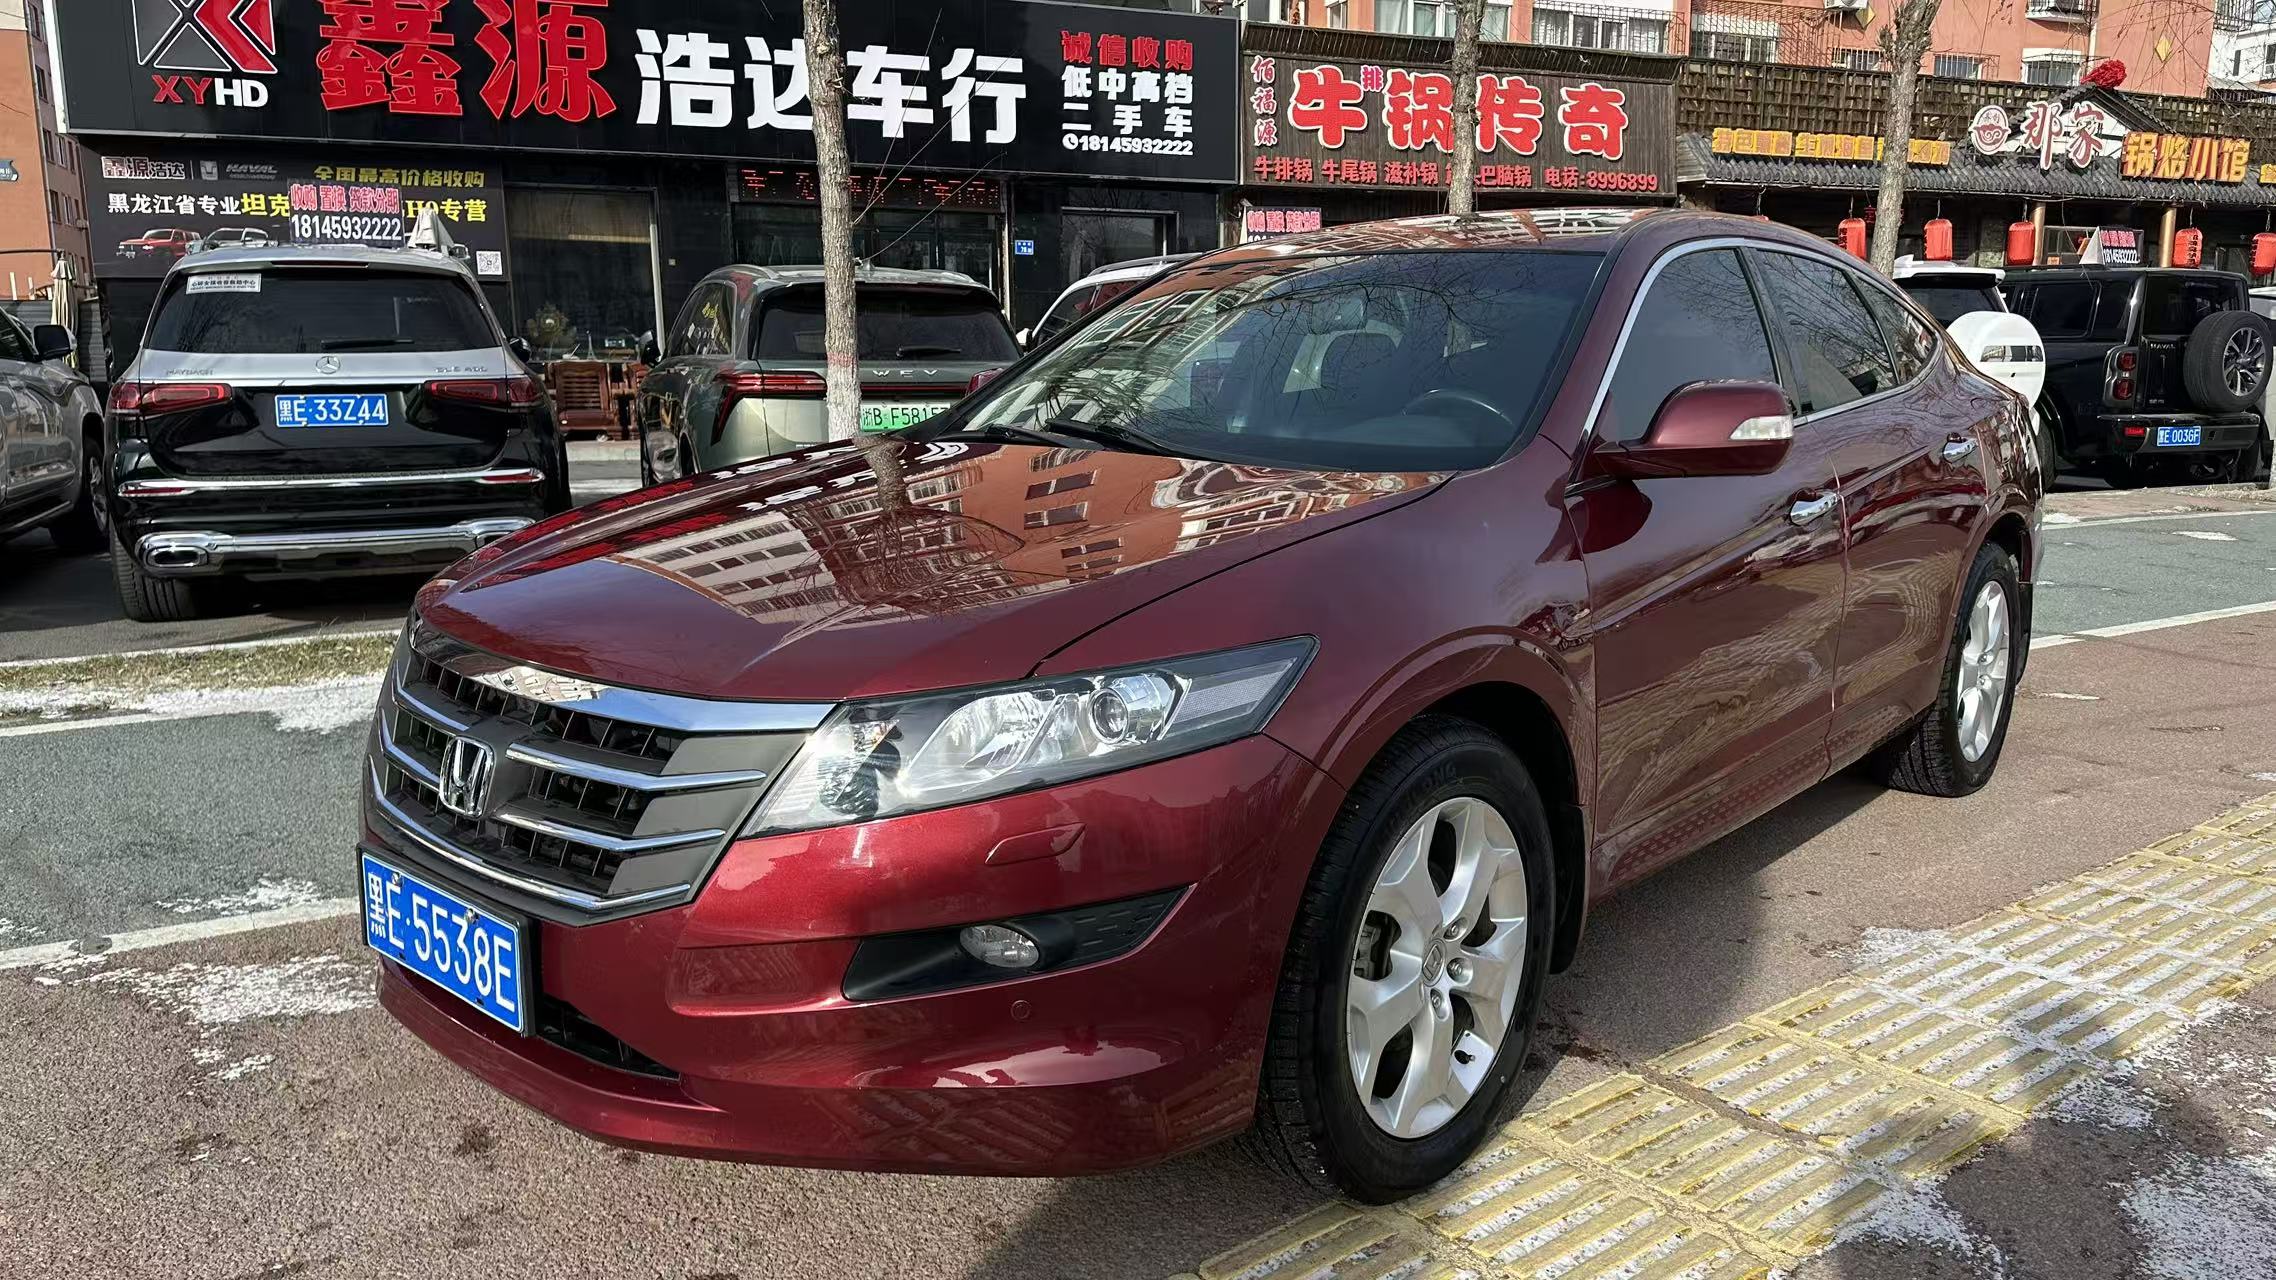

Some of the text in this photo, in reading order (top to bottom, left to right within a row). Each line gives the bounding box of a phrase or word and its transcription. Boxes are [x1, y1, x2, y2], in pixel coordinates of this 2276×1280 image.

[1061, 31, 1193, 71] 诚信收购
[152, 74, 269, 108] XYHD
[1061, 65, 1193, 104] 低中高档
[1250, 55, 1277, 147] 佰福源
[1062, 102, 1193, 138] 二手车
[2020, 101, 2107, 170] 那家
[1078, 134, 1193, 155] 18145932222
[101, 156, 186, 180] 鑫源浩达
[314, 165, 485, 188] 全国最高价格收购
[1254, 155, 1313, 183] 牛排锅
[1321, 158, 1378, 185] 牛尾锅
[1384, 161, 1439, 186] 滋补锅
[107, 192, 290, 217] 黑龙江省专业坦克
[291, 184, 400, 214] 收购 置换 贷款分期
[291, 215, 402, 240] 18145932222
